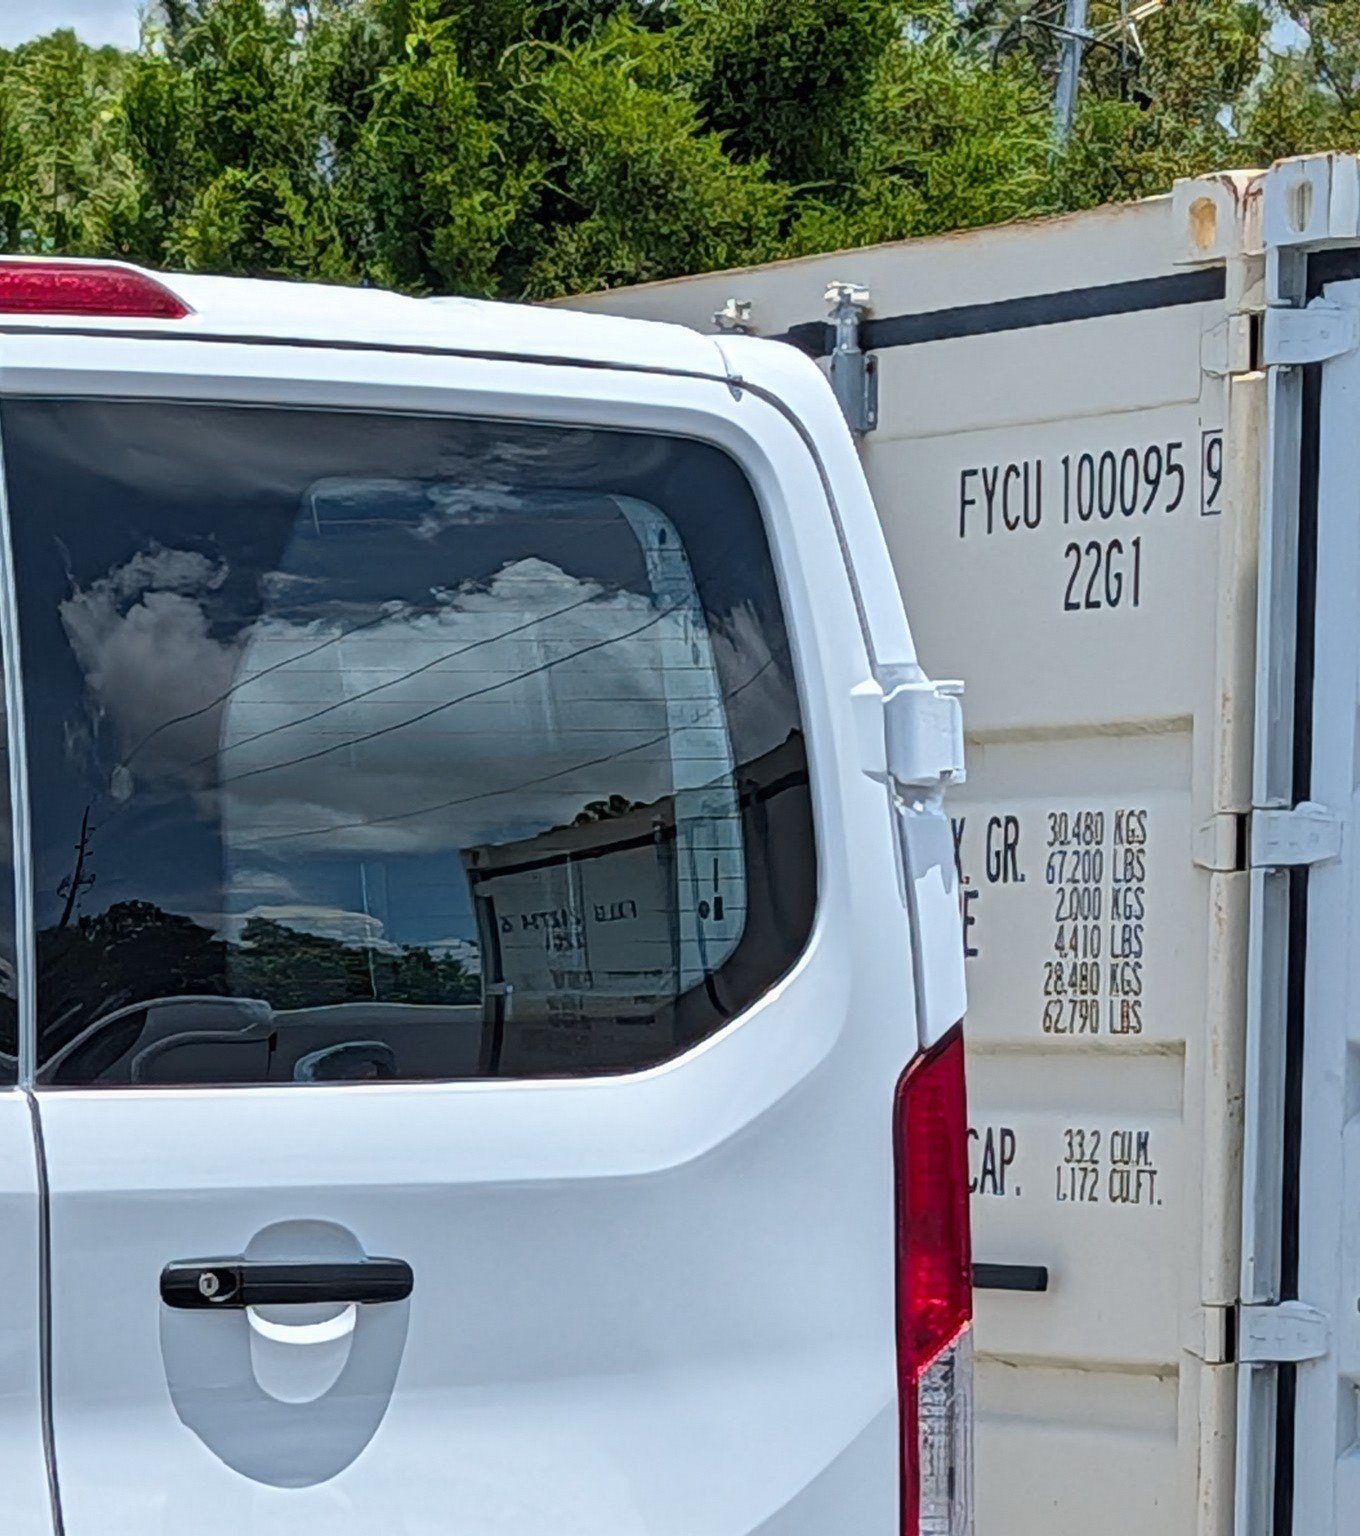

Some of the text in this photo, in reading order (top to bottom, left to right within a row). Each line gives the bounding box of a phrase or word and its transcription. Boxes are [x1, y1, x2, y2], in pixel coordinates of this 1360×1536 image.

[959, 436, 1224, 538] FYCU 100095 9
[1063, 535, 1141, 611] 22G1
[1113, 809, 1148, 846] KGS
[985, 815, 1026, 884] GR.
[1112, 847, 1146, 883] LBS
[1111, 886, 1145, 922] KGS
[1110, 923, 1144, 959] LBS
[1109, 960, 1143, 997] KGS
[1109, 998, 1142, 1034] LBS
[966, 1126, 1022, 1197] CAP.
